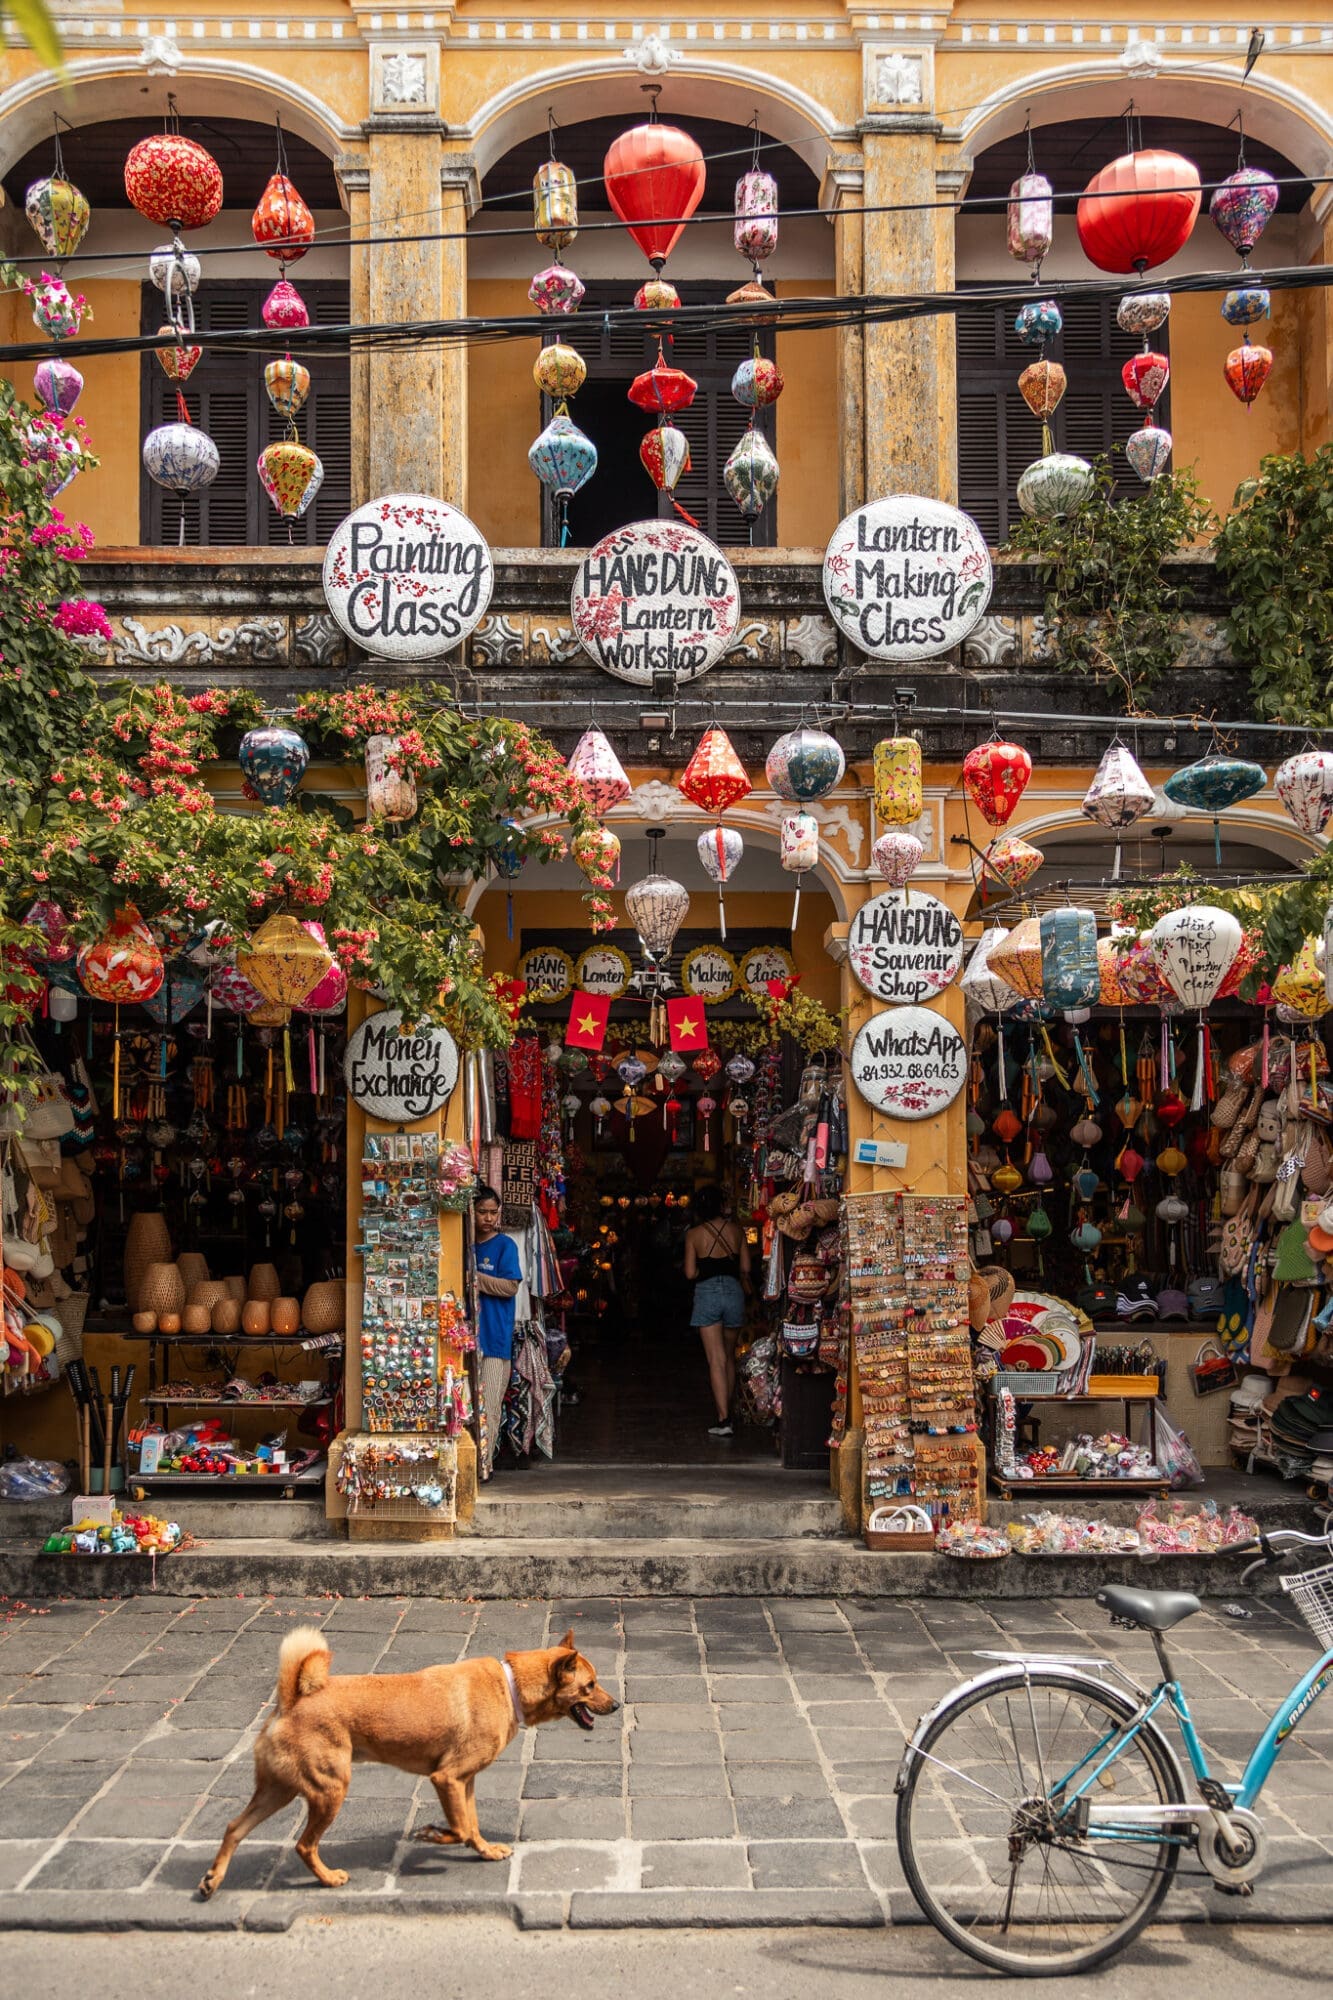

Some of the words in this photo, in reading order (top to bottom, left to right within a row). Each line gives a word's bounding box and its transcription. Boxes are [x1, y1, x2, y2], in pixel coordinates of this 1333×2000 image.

[857, 514, 962, 553] Lantern
[350, 521, 489, 618] Painting
[660, 545, 728, 598] DŨNG
[854, 558, 962, 621] Making
[347, 578, 462, 638] Class
[621, 600, 717, 631] Lantern
[859, 601, 946, 647] Class
[594, 631, 708, 676] Workshop
[913, 901, 962, 947] DŨNG
[688, 962, 734, 992] Making
[744, 961, 787, 984] Class
[871, 946, 953, 971] Souvenir
[877, 971, 928, 1002] Shop
[361, 1024, 442, 1077] Money
[865, 1026, 965, 1062] WhatsApp
[352, 1061, 451, 1116] Exchange
[1288, 1683, 1321, 1725] martin
